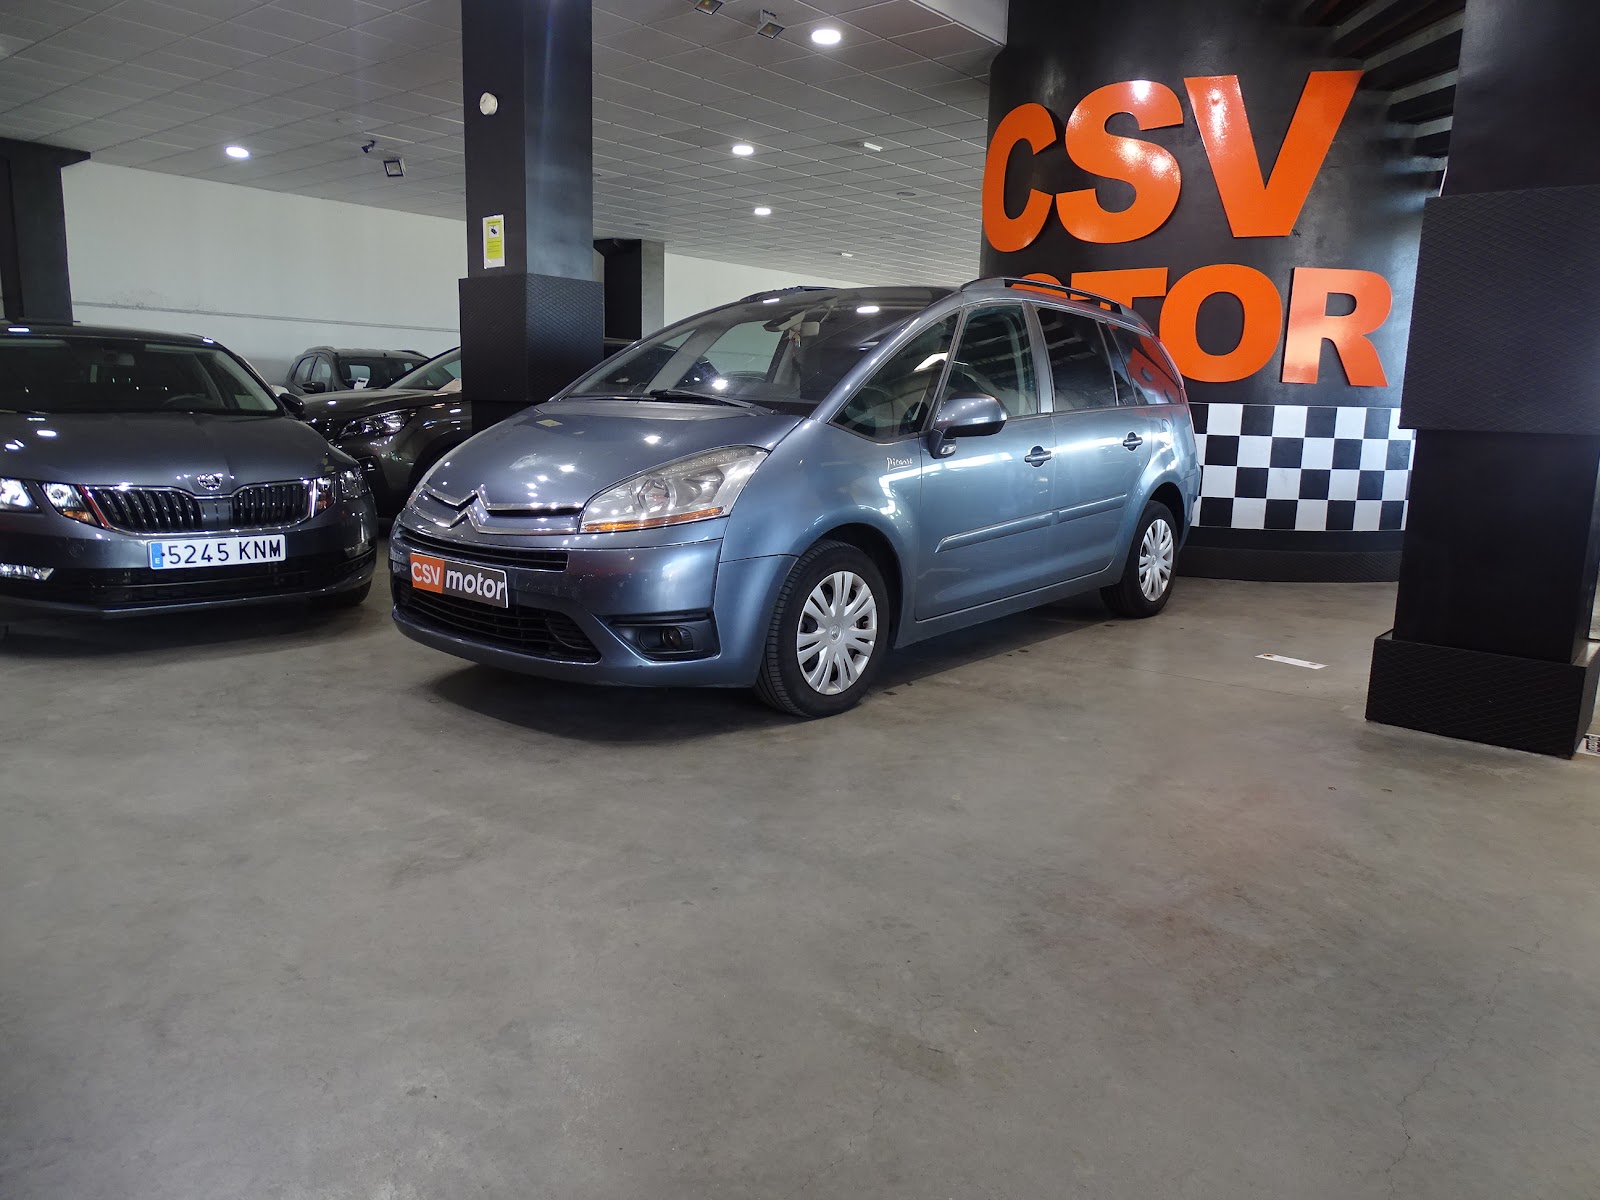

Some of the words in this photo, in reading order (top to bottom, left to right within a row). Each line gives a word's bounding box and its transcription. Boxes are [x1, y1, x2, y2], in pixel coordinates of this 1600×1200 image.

[982, 70, 1364, 252] CSV
[1010, 264, 1393, 387] TOR
[168, 543, 229, 565] 5245
[239, 539, 281, 560] KNM
[411, 561, 440, 586] CSV
[446, 569, 505, 600] motor
